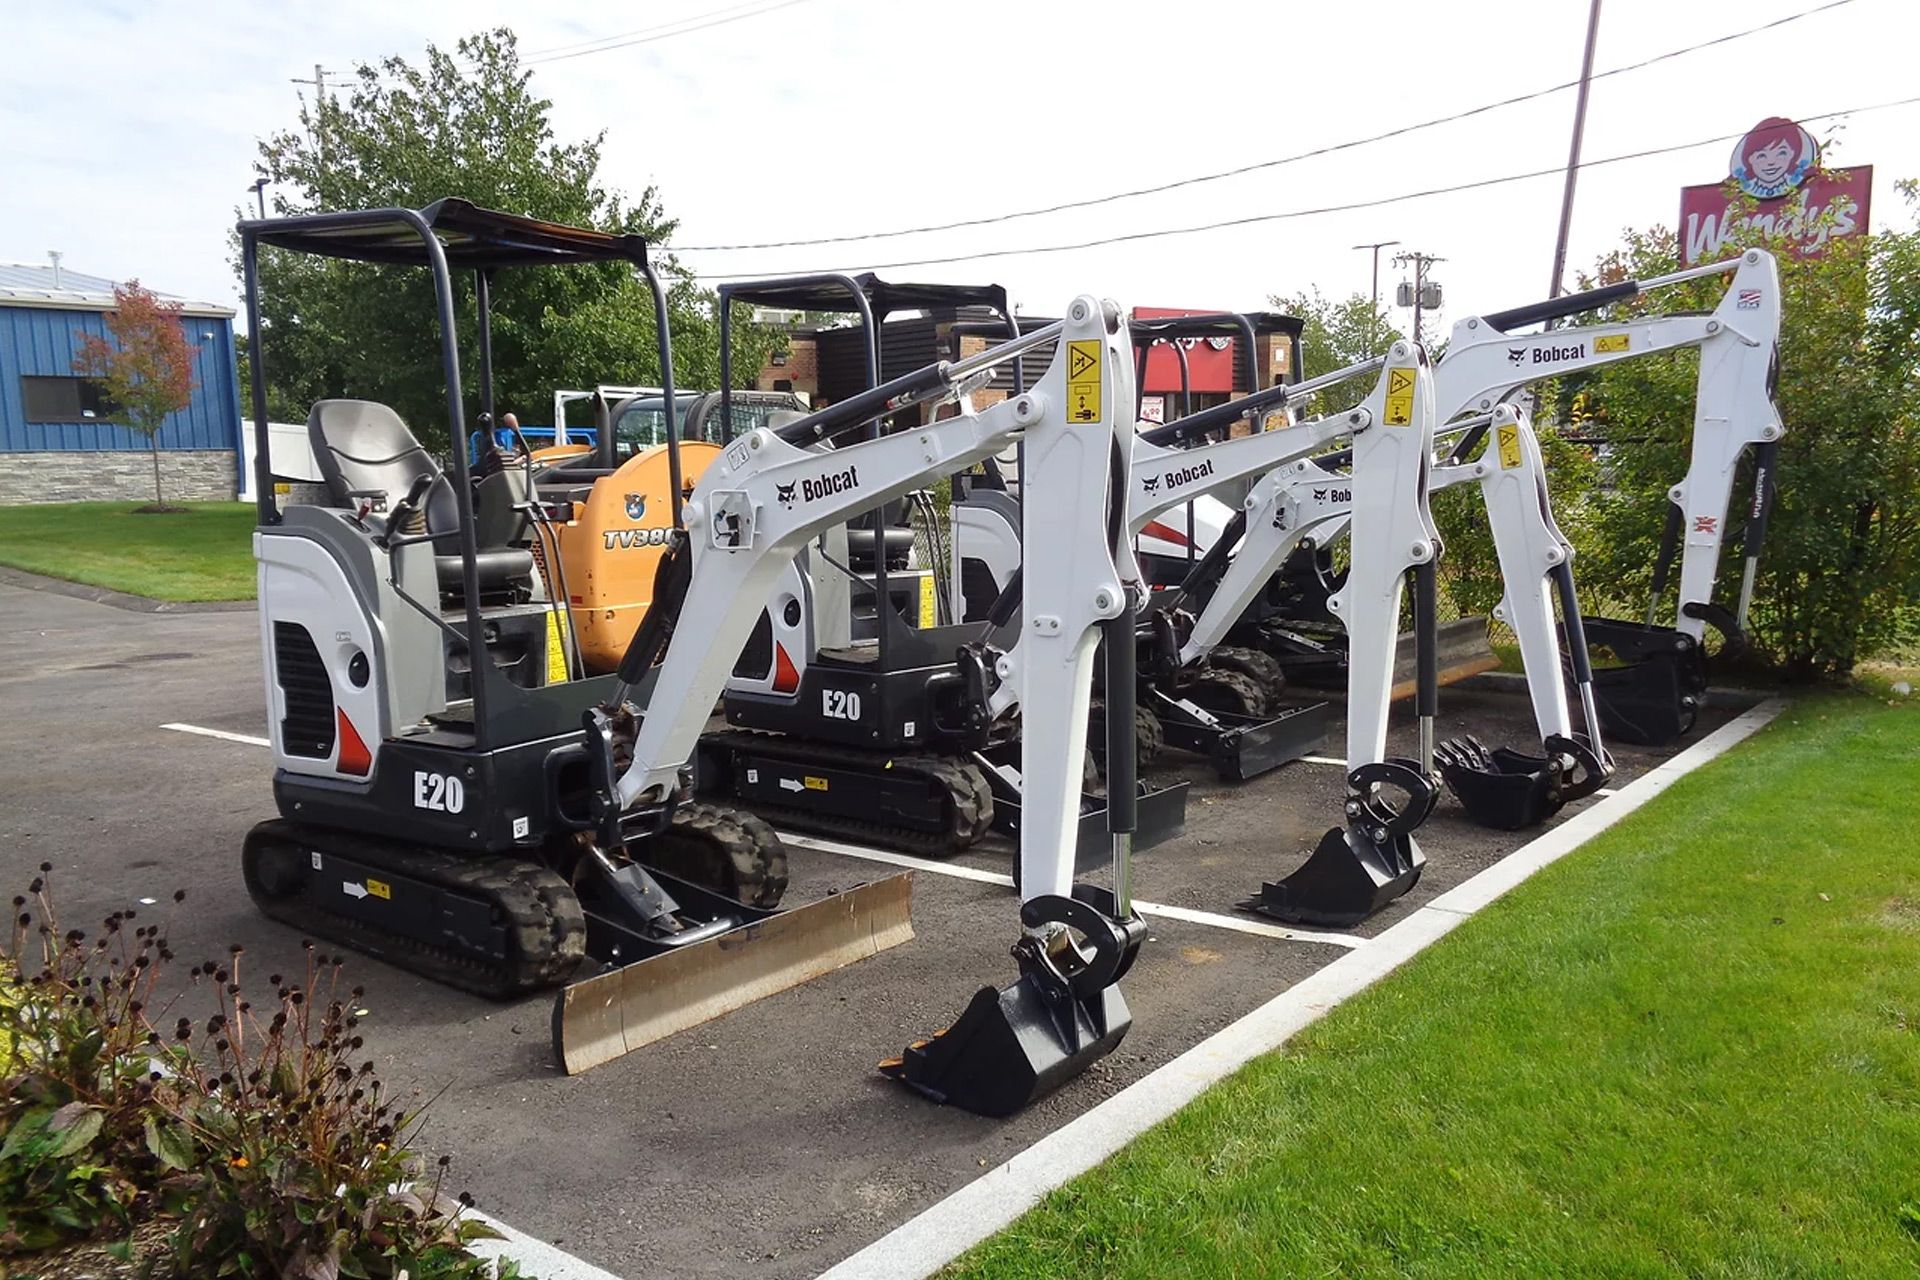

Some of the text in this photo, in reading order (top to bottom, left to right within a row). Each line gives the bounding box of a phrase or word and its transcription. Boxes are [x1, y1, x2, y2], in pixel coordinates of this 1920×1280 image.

[1686, 188, 1858, 264] Wndys
[1533, 343, 1584, 363] Bobcat
[802, 465, 859, 502] Bobcat
[1164, 459, 1214, 489] Bobcat
[1331, 488, 1351, 502] Bob
[823, 689, 861, 721] E20
[414, 770, 464, 814] E20
